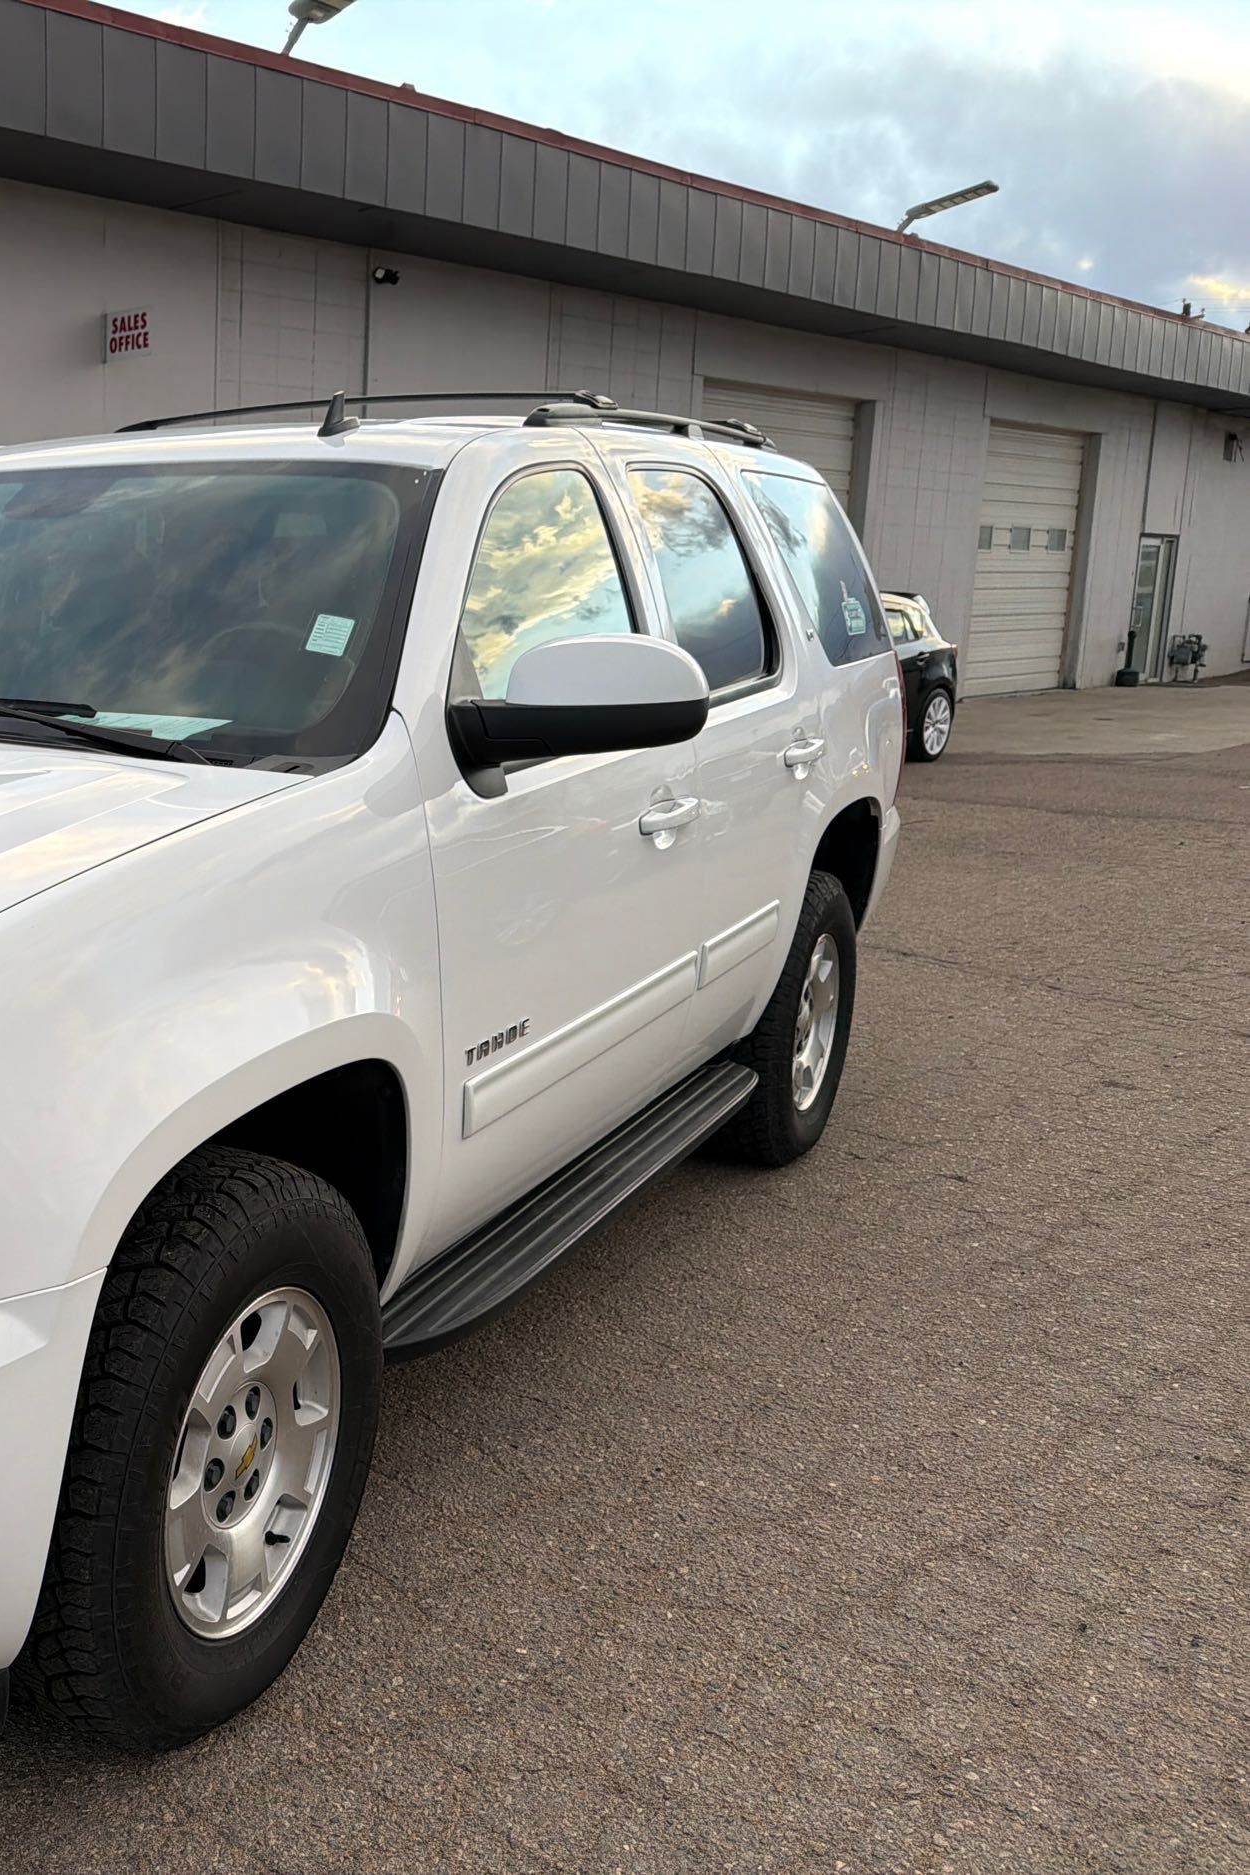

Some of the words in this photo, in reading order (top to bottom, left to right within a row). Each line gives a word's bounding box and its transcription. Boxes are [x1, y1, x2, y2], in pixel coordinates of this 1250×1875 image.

[112, 312, 147, 334] SALES
[110, 332, 149, 353] OFFICE
[465, 1018, 530, 1066] TAHOE
